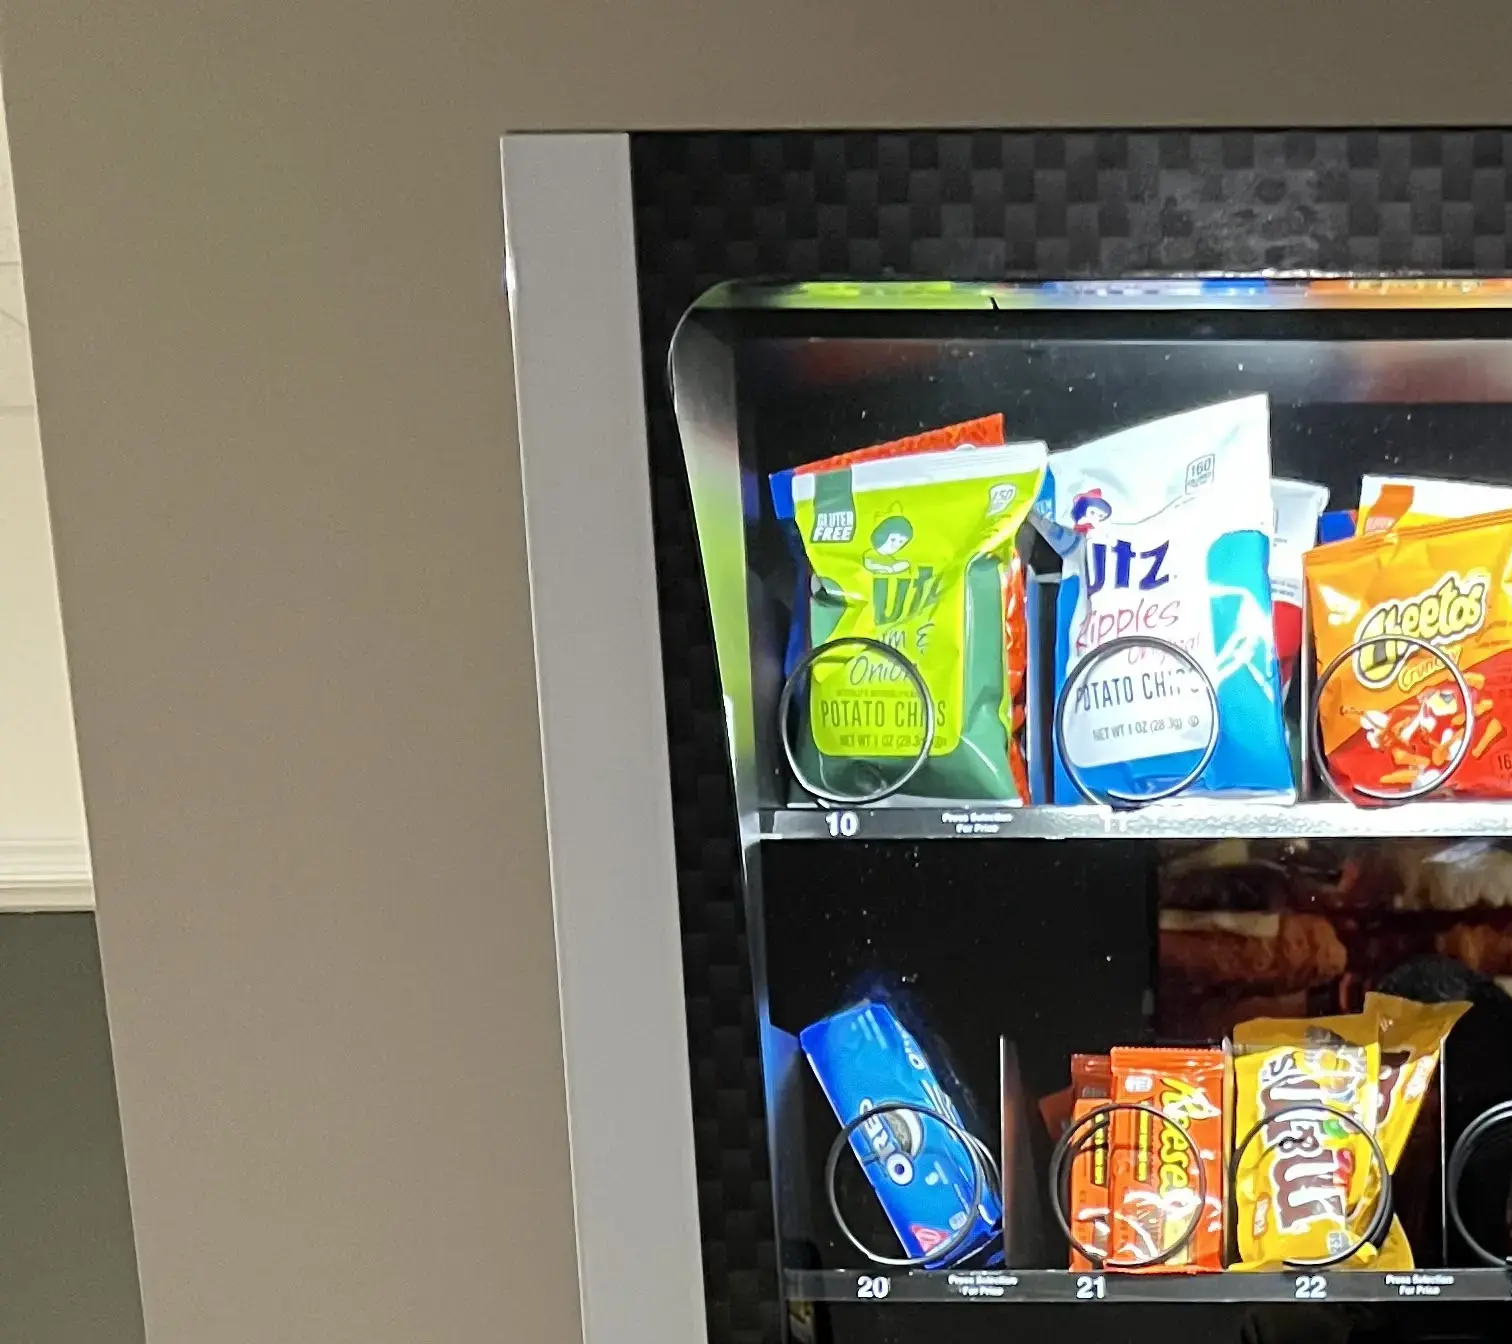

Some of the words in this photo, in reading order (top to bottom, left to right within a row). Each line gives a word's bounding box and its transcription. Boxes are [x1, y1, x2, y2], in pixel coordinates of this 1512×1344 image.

[1190, 458, 1211, 477] 160
[813, 526, 852, 542] FREE
[1358, 577, 1485, 683] Cheetos
[1074, 674, 1133, 714] POTATO
[821, 700, 885, 727] POTATO
[1111, 722, 1125, 738] WT
[1135, 719, 1147, 732] OZ
[858, 734, 871, 748] WT
[882, 734, 893, 747] OZ
[826, 811, 858, 836] 10
[859, 1098, 914, 1185] OREO
[857, 1277, 889, 1298] 20
[1076, 1276, 1106, 1299] 21
[1295, 1276, 1327, 1299] 22
